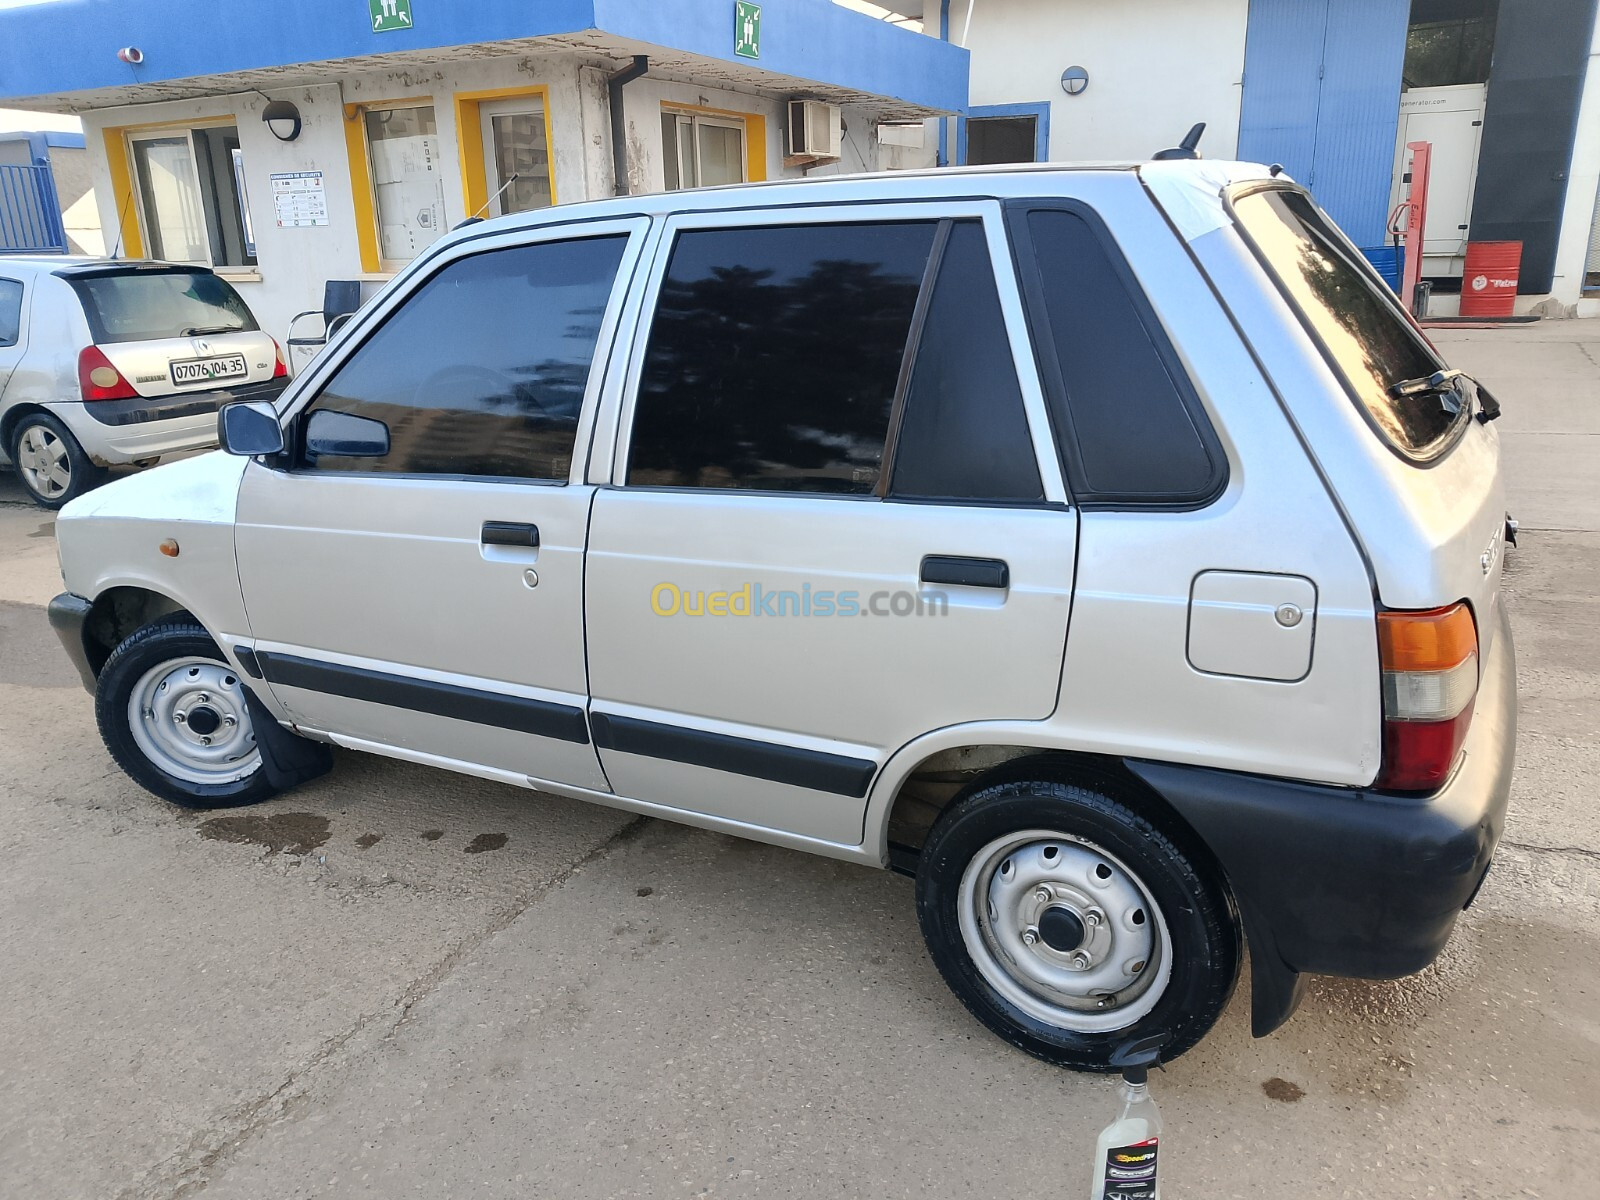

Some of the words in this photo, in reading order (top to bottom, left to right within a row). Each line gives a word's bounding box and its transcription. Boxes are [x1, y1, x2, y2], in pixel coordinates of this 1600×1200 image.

[1401, 99, 1447, 107] generator.com
[175, 363, 208, 379] 07076
[210, 361, 228, 374] 104
[229, 359, 243, 372] 35
